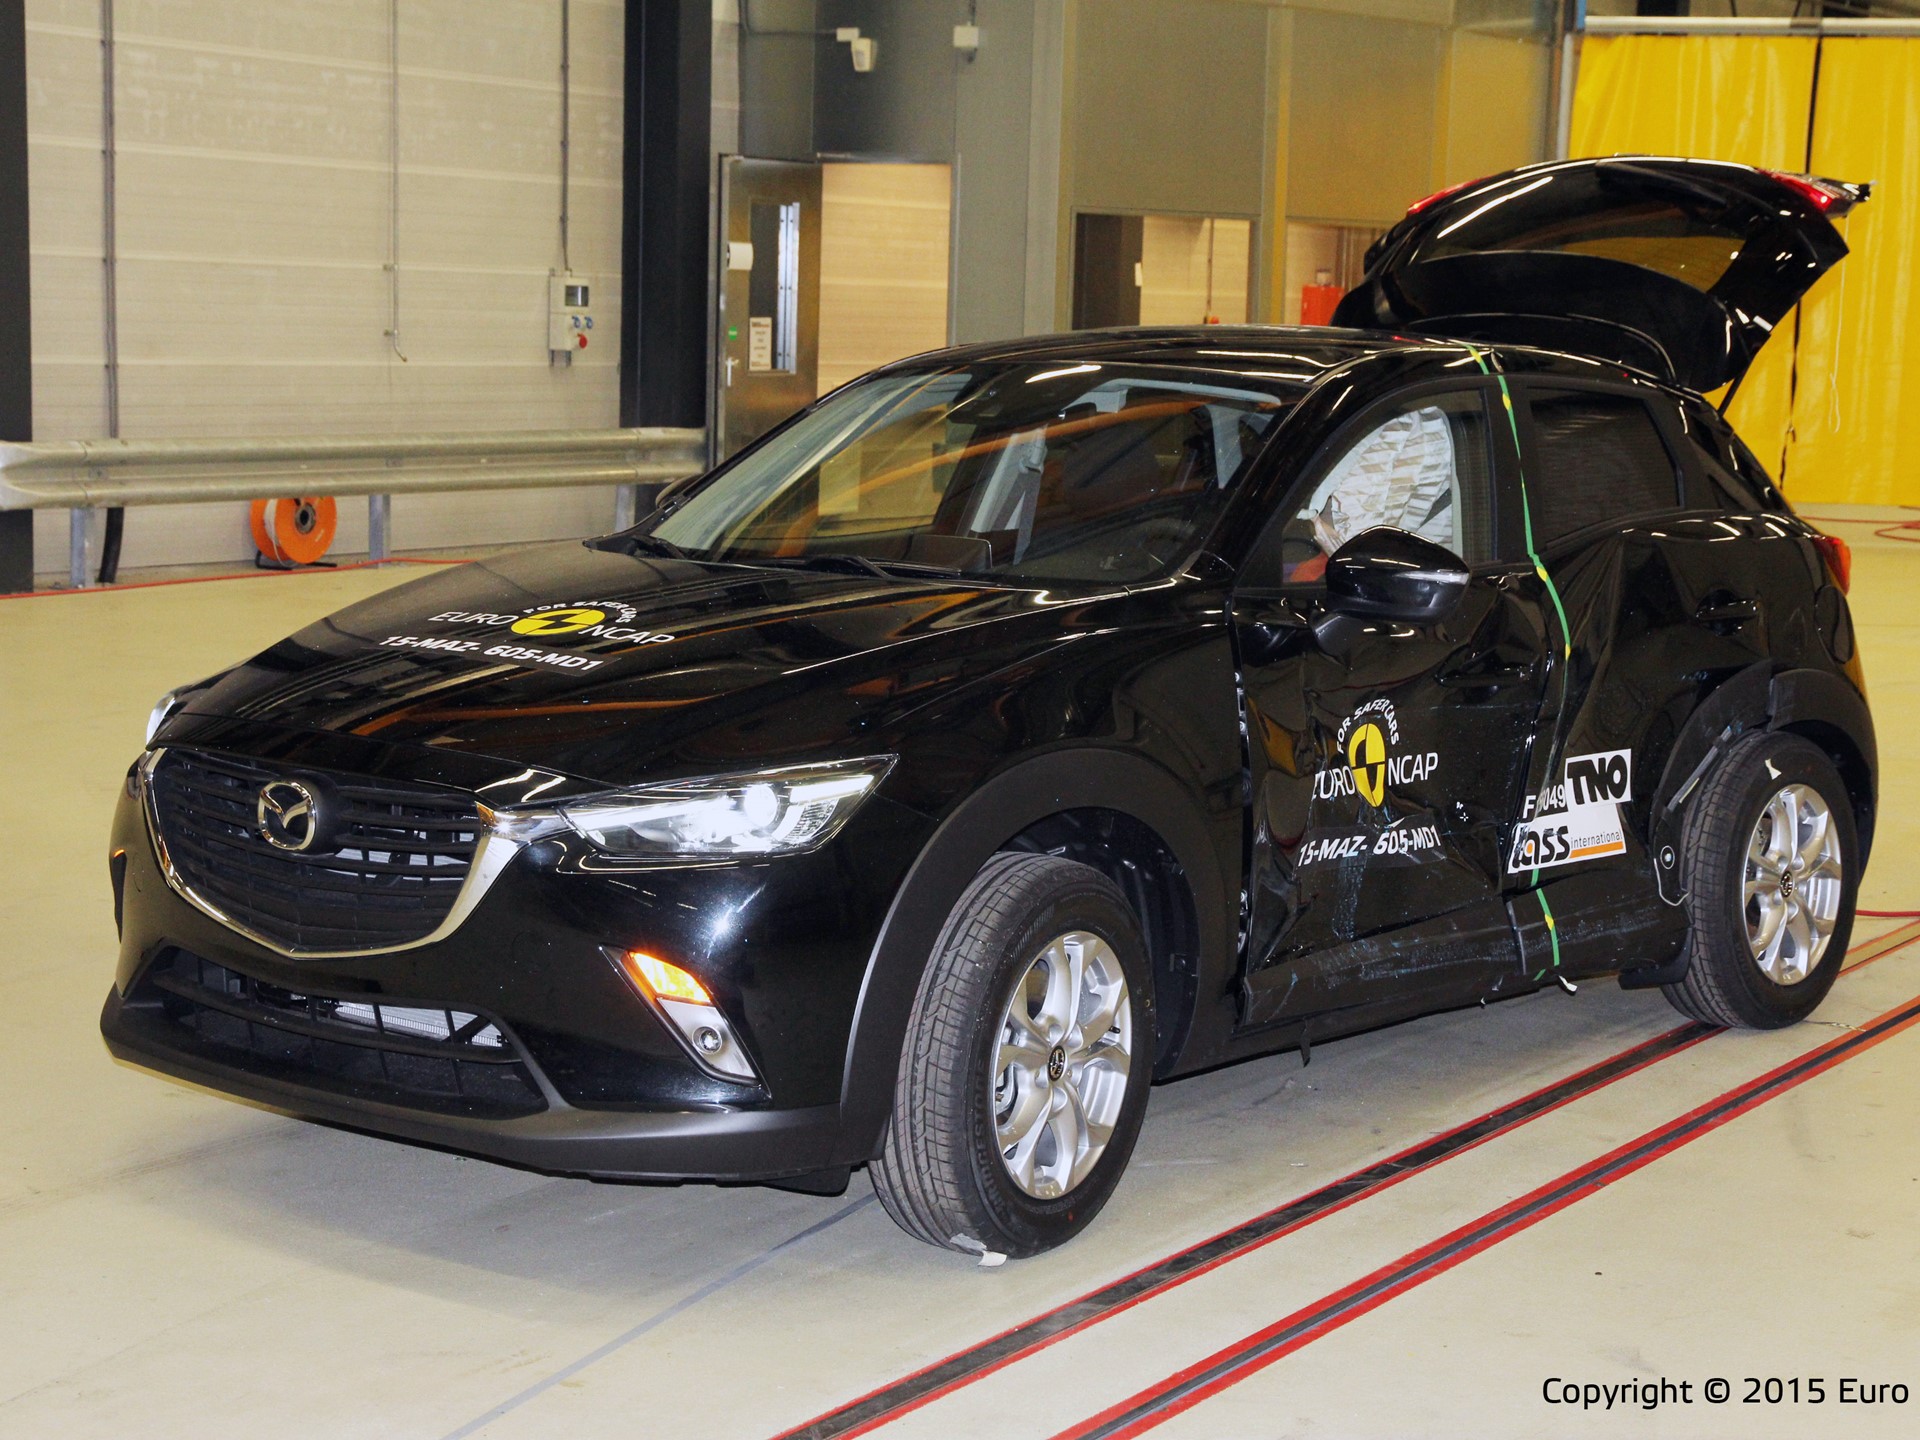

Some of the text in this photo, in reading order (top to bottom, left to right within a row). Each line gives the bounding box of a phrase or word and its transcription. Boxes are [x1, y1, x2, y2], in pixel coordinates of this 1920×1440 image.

[428, 611, 675, 645] EURO NCAP
[483, 645, 604, 671] 605-MD1
[1336, 698, 1400, 754] FOR SAFER CARS
[1388, 752, 1439, 786] NCAP
[1567, 754, 1628, 806] TNO
[1571, 830, 1623, 848] international
